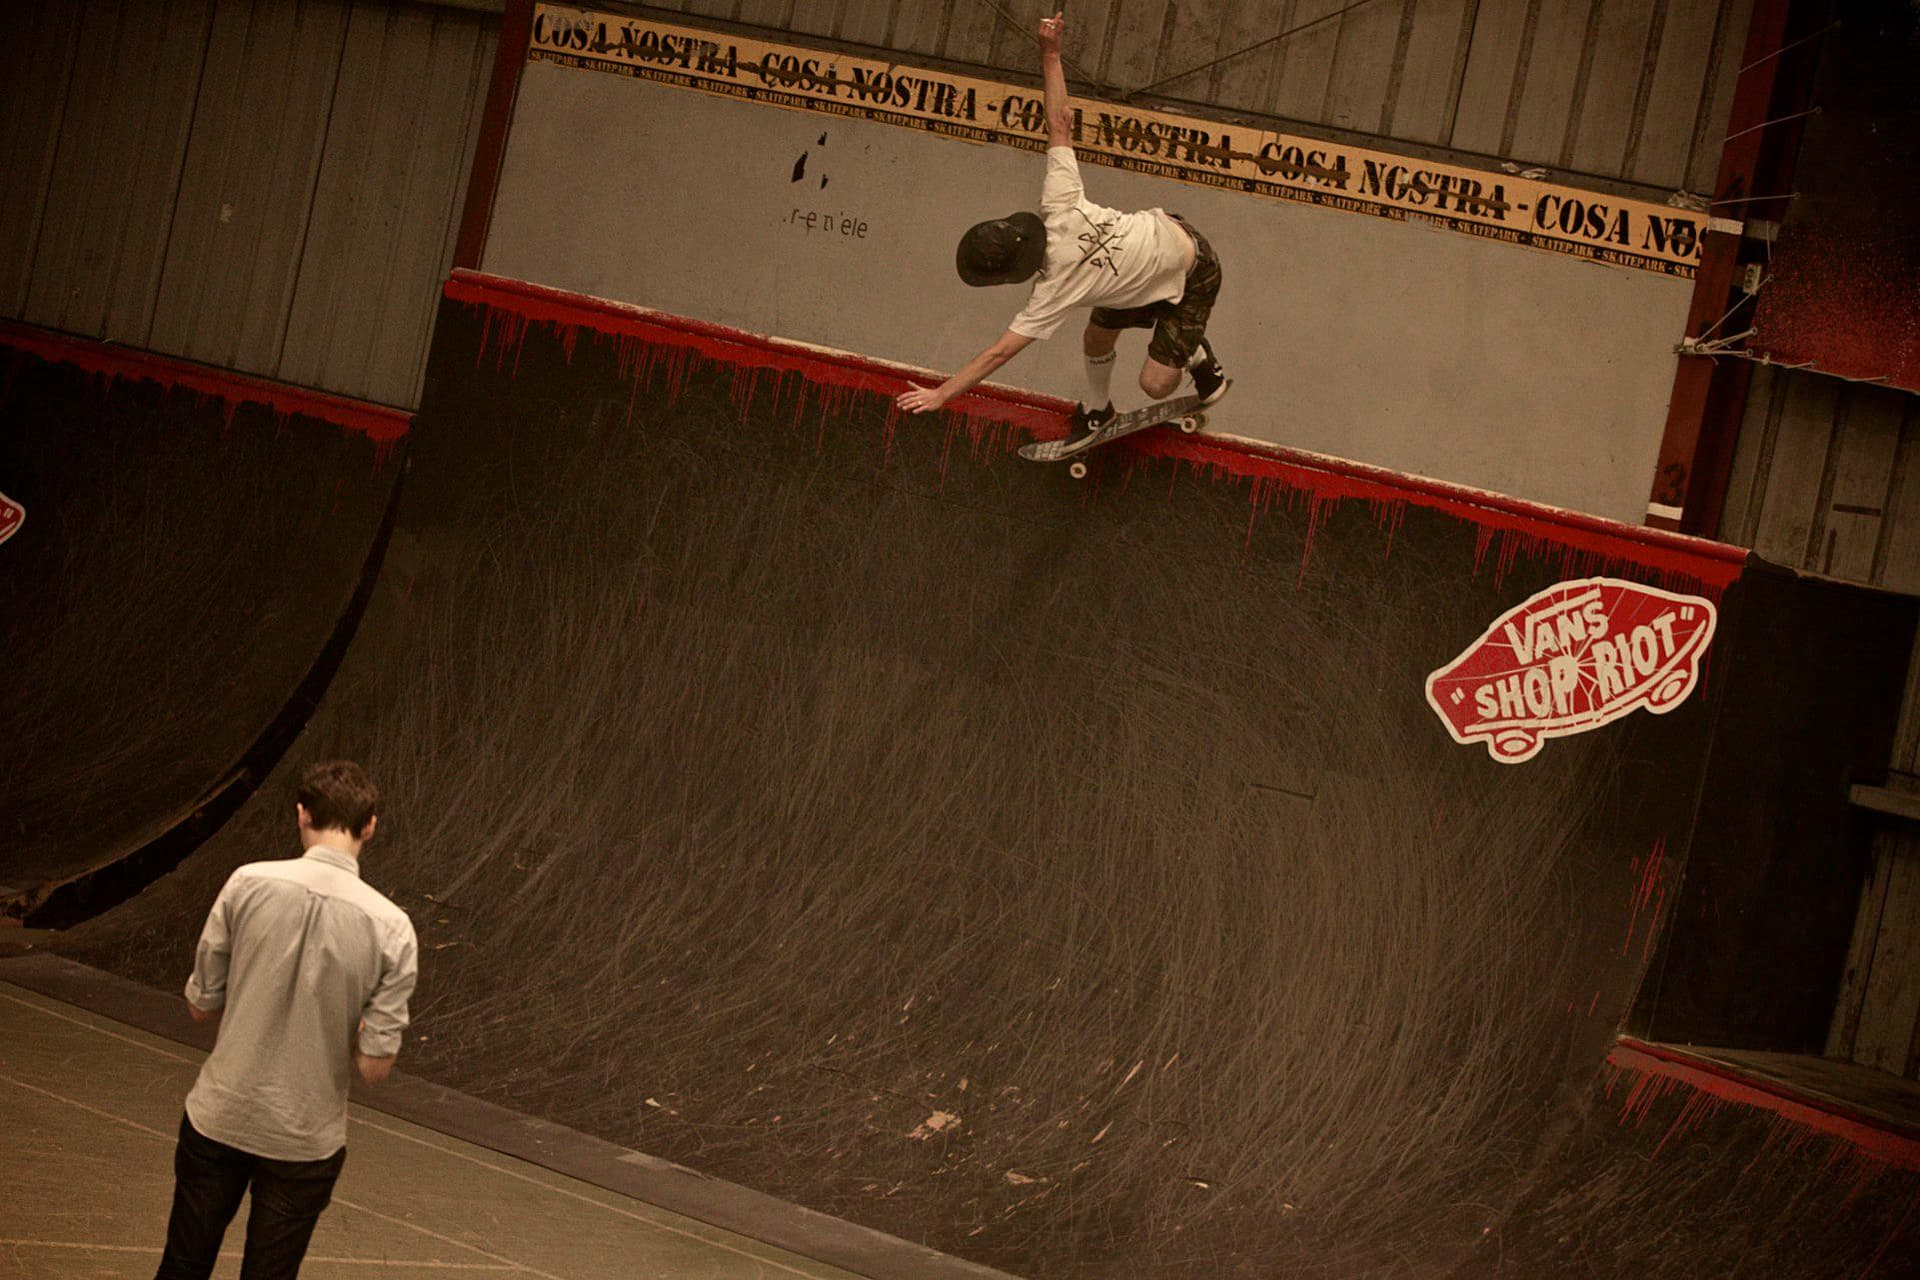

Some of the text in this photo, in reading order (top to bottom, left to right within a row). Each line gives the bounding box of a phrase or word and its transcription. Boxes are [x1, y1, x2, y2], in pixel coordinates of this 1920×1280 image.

[534, 13, 607, 53] COSA
[615, 26, 737, 77] NOSTRA
[759, 52, 837, 95] COSA
[847, 67, 977, 120] NOSTRA
[1094, 112, 1231, 169] NOSTRA
[1259, 142, 1347, 190] COSA
[1535, 194, 1630, 245] COSA
[582, 58, 635, 77] SKATEPARK
[638, 68, 691, 87] SKATEPARK
[695, 78, 748, 98] SKATEPARK
[754, 89, 808, 109] SKATEPARK
[812, 100, 866, 119] SKATEPARK
[871, 110, 927, 130] SKATEPARK
[932, 120, 988, 141] SKATEPARK
[995, 133, 1048, 154] SKATEPAR
[1076, 148, 1116, 167] TEPARK
[1120, 157, 1180, 179] SKATEPARK
[1183, 168, 1245, 191] SKATEPARK
[1253, 181, 1315, 203] SKATEPARK
[1319, 194, 1382, 216] SKATEPARK
[1455, 220, 1519, 243] SKATEPARK
[1530, 234, 1595, 258] SKATEPARK
[1600, 249, 1667, 273] SKATEPARK
[1503, 589, 1609, 665] VANS
